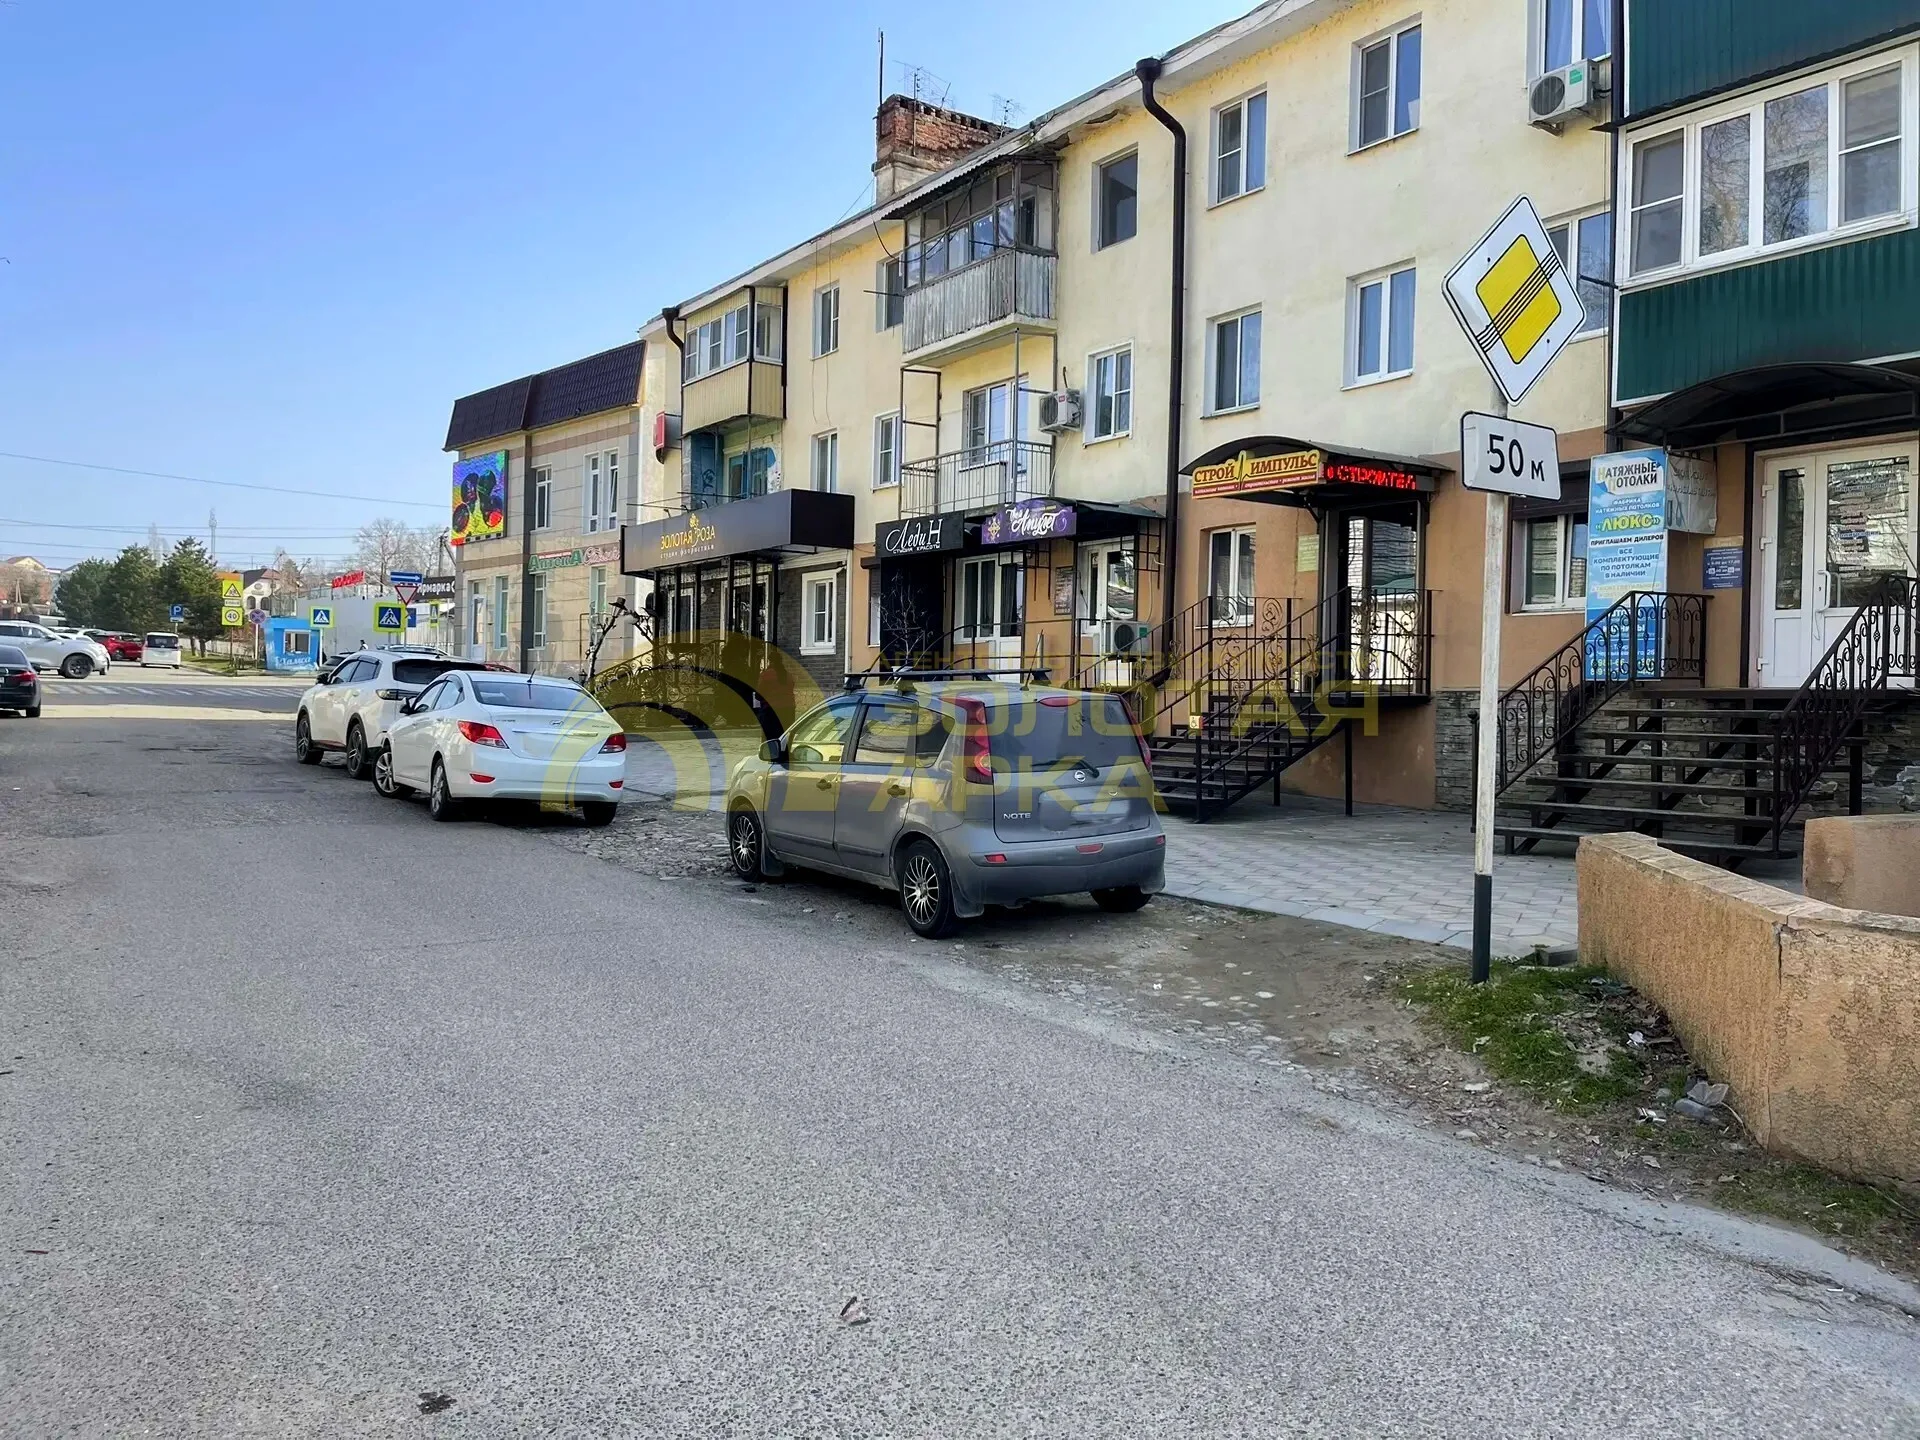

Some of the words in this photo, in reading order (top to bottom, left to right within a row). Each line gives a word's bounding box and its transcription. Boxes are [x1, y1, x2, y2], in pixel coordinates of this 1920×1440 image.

[1487, 433, 1524, 477] 50
[1194, 463, 1235, 482] СТРОЙ
[1250, 453, 1317, 475] ИМПУЛЬС
[1628, 502, 1660, 511] ПОТОЛКОВ
[660, 530, 693, 550] ЗОЛОТАЯ
[691, 525, 716, 548] РОЗА
[885, 519, 927, 552] Леди
[927, 518, 943, 545] Н
[1590, 537, 1632, 547] ПРИГЛАШАЕМ
[1633, 534, 1664, 543] ДИЛЕРОВ
[916, 544, 941, 552] КРАСОТЫ
[1619, 547, 1633, 555] ВСЕ
[1593, 553, 1660, 565] КОМПЛЕКТУЮЩИЕ
[1611, 562, 1651, 571] ПОТОЛКАМ
[1610, 570, 1646, 578] НАЛИЧИИ
[227, 612, 238, 620] 40
[1003, 812, 1032, 820] NOTE
